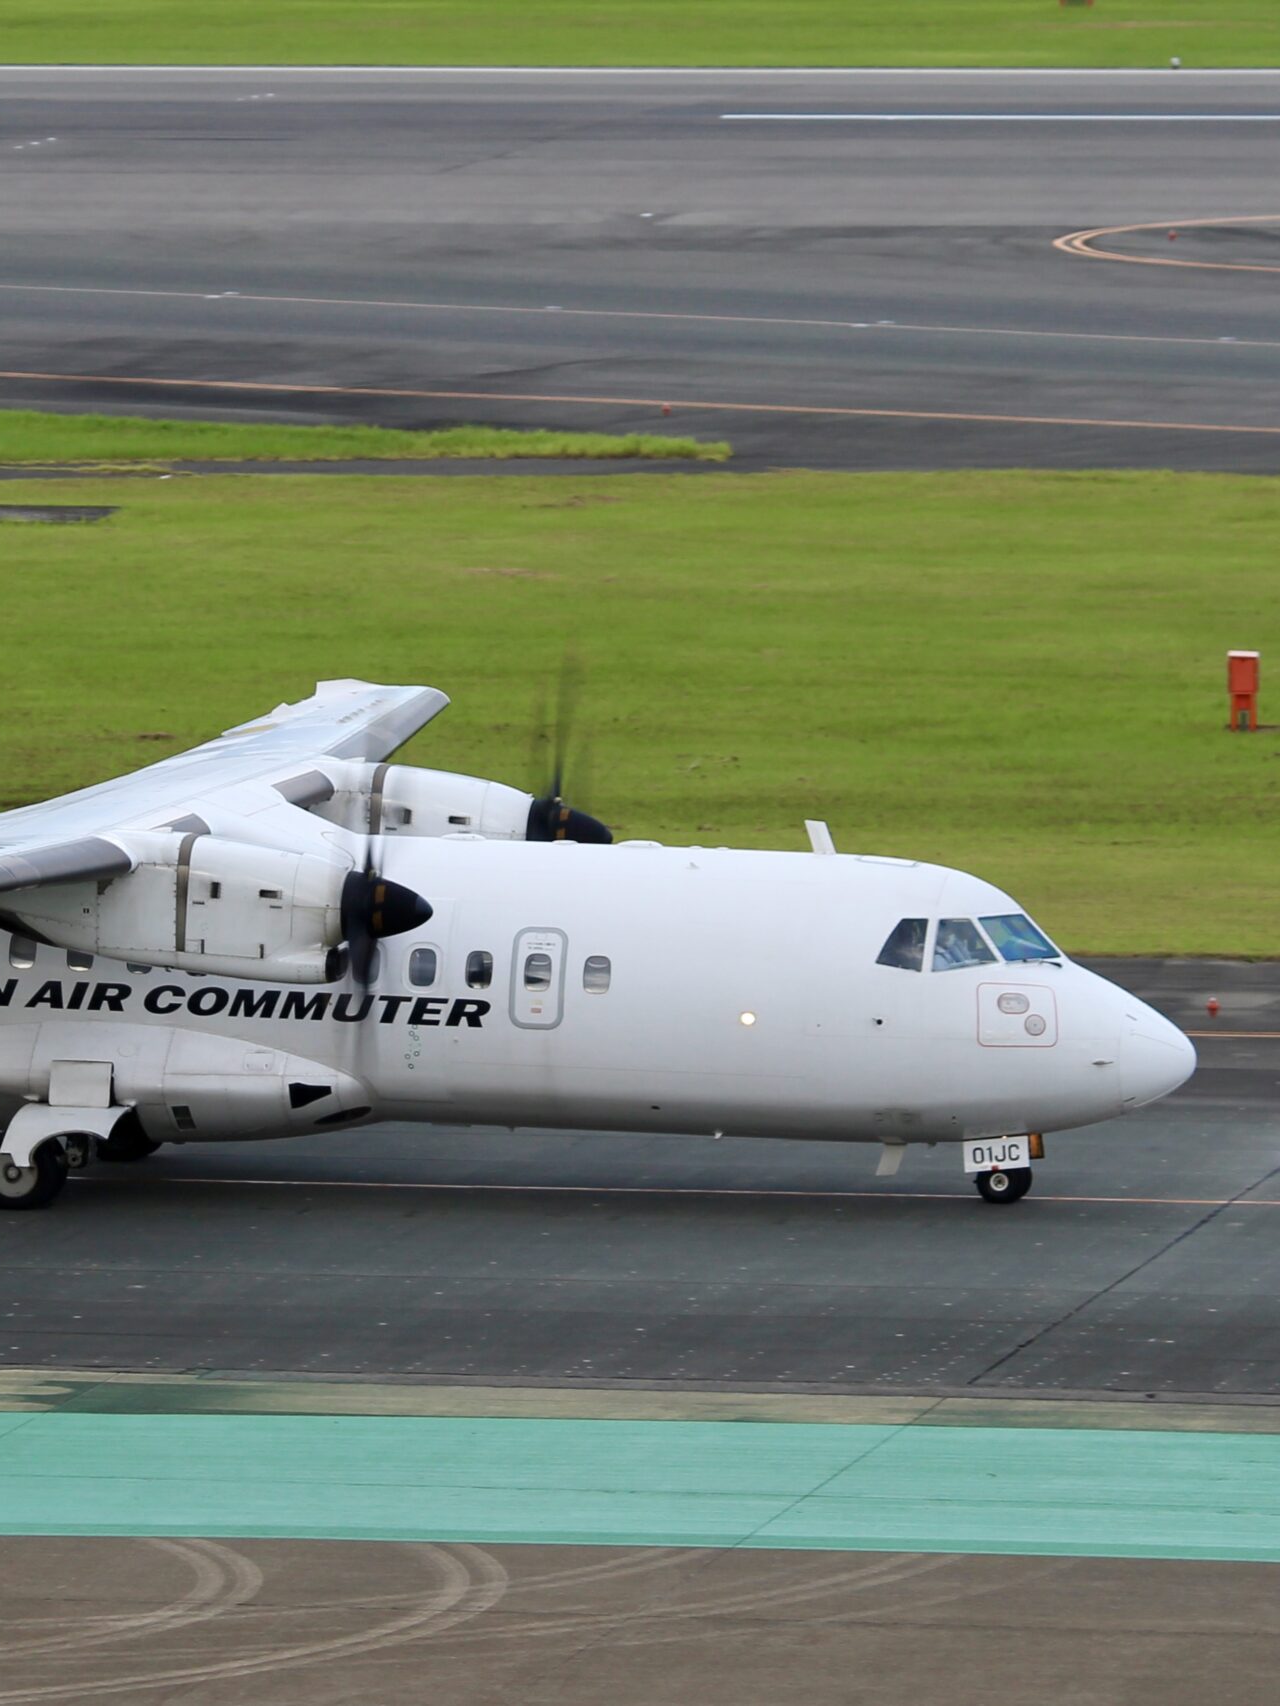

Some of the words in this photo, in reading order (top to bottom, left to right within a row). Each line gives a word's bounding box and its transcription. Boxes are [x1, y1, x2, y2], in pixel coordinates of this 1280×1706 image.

[23, 980, 133, 1012] AIR
[143, 984, 491, 1028] COMMUTER
[972, 1143, 1021, 1165] 01JC
